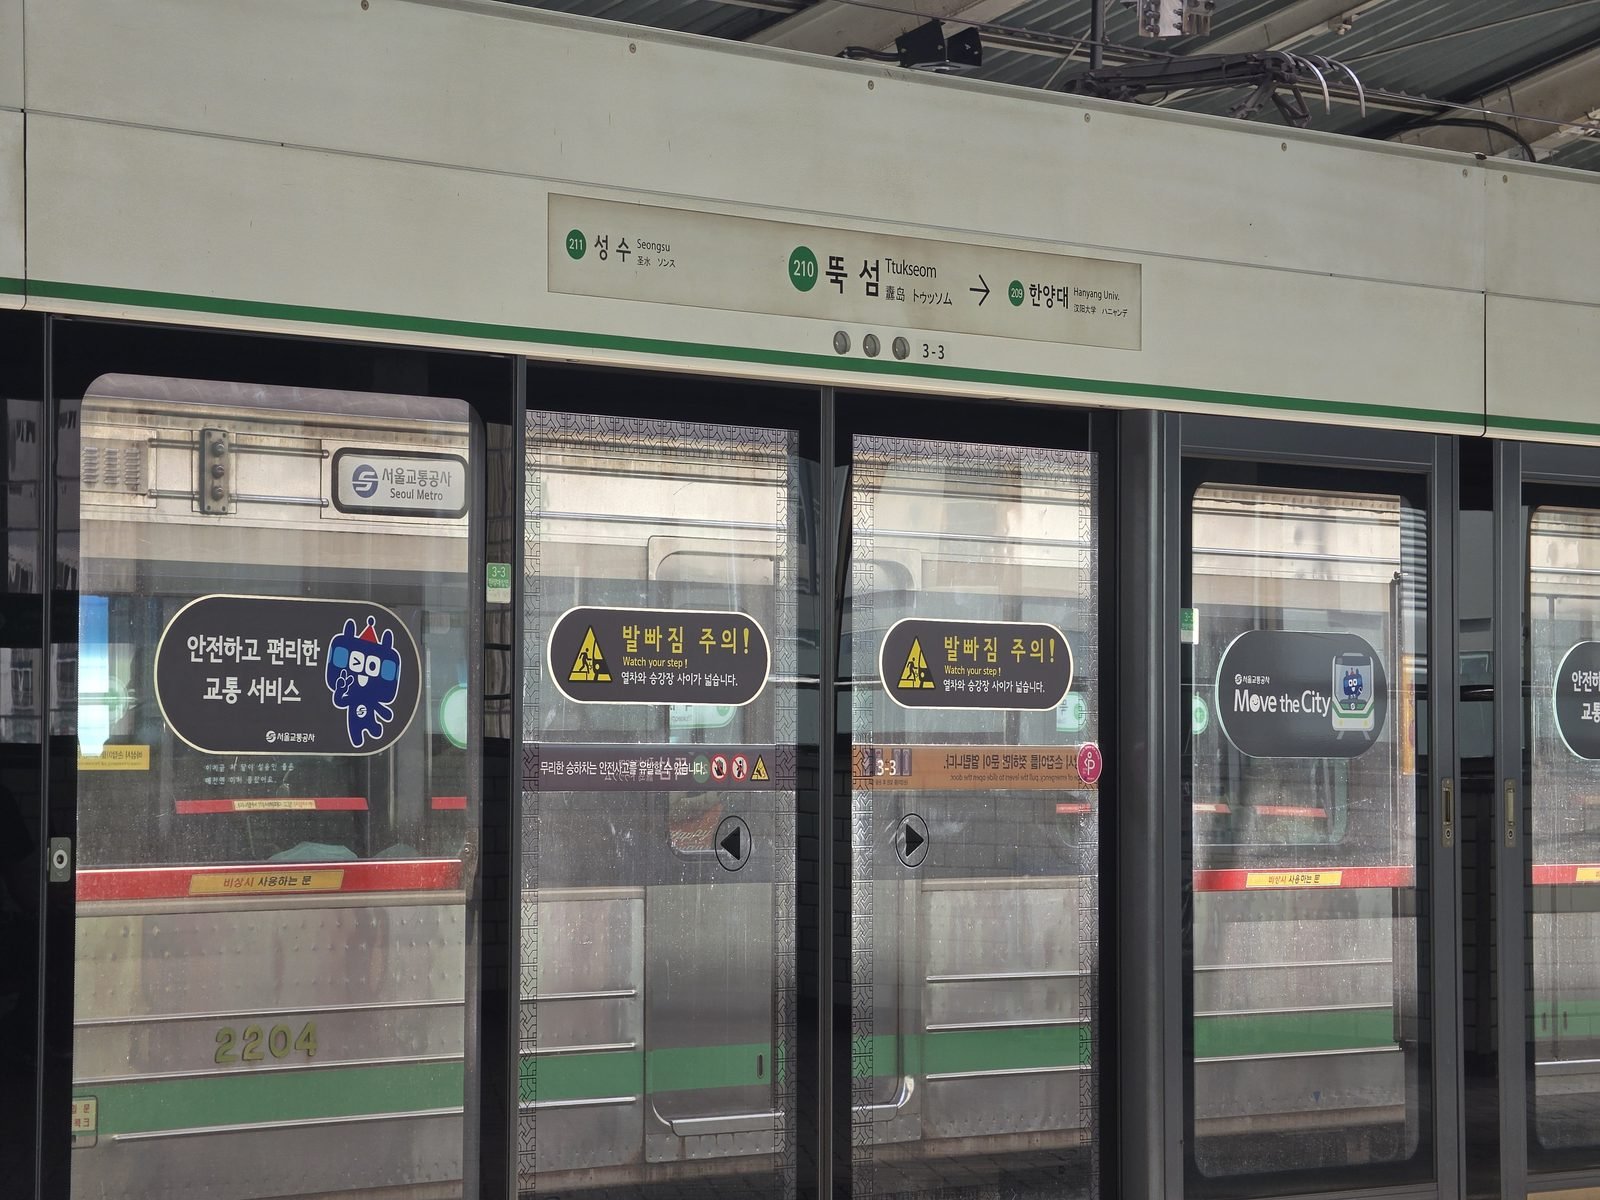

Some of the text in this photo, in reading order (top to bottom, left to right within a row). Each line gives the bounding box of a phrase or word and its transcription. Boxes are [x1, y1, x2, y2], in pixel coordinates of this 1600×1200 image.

[569, 238, 583, 250] 211
[637, 238, 671, 252] Seongsu
[793, 260, 814, 278] 210
[885, 258, 937, 278] Ttukseom
[1011, 288, 1023, 298] 209
[1029, 284, 1069, 309] 한양대
[1074, 287, 1120, 301] Hanyang Univ.
[1074, 304, 1097, 314] 汉阳大学
[922, 344, 946, 359] 3-3
[382, 467, 452, 487] 서울교통공사
[390, 488, 443, 501] Seoul Metro
[492, 566, 506, 577] 3-3
[622, 625, 684, 654] 발빠짐
[187, 634, 320, 666] 안전하고 편리한
[944, 636, 998, 663] 발빠짐
[623, 656, 646, 667] Watch
[649, 659, 665, 668] your
[944, 665, 965, 675] Watch
[967, 667, 981, 676] your
[621, 671, 738, 687] 열차와 승강장 사이가 넓습니다.
[943, 679, 1045, 694] 열차와 승강장 사이가 넓습니다.
[1243, 674, 1270, 685] 서울교통공사
[203, 676, 301, 704] 교통 서비스
[1234, 689, 1331, 717] Move the City
[277, 732, 315, 743] 서울교통공사
[540, 761, 564, 775] 무리한
[566, 761, 597, 775] 승하차는
[599, 761, 637, 775] 안전사고를
[639, 761, 661, 775] 유발할
[664, 761, 673, 775] 수
[877, 759, 896, 776] 3-3
[224, 875, 312, 888] 비상시 사용하는 문
[214, 1021, 317, 1064] 2204
